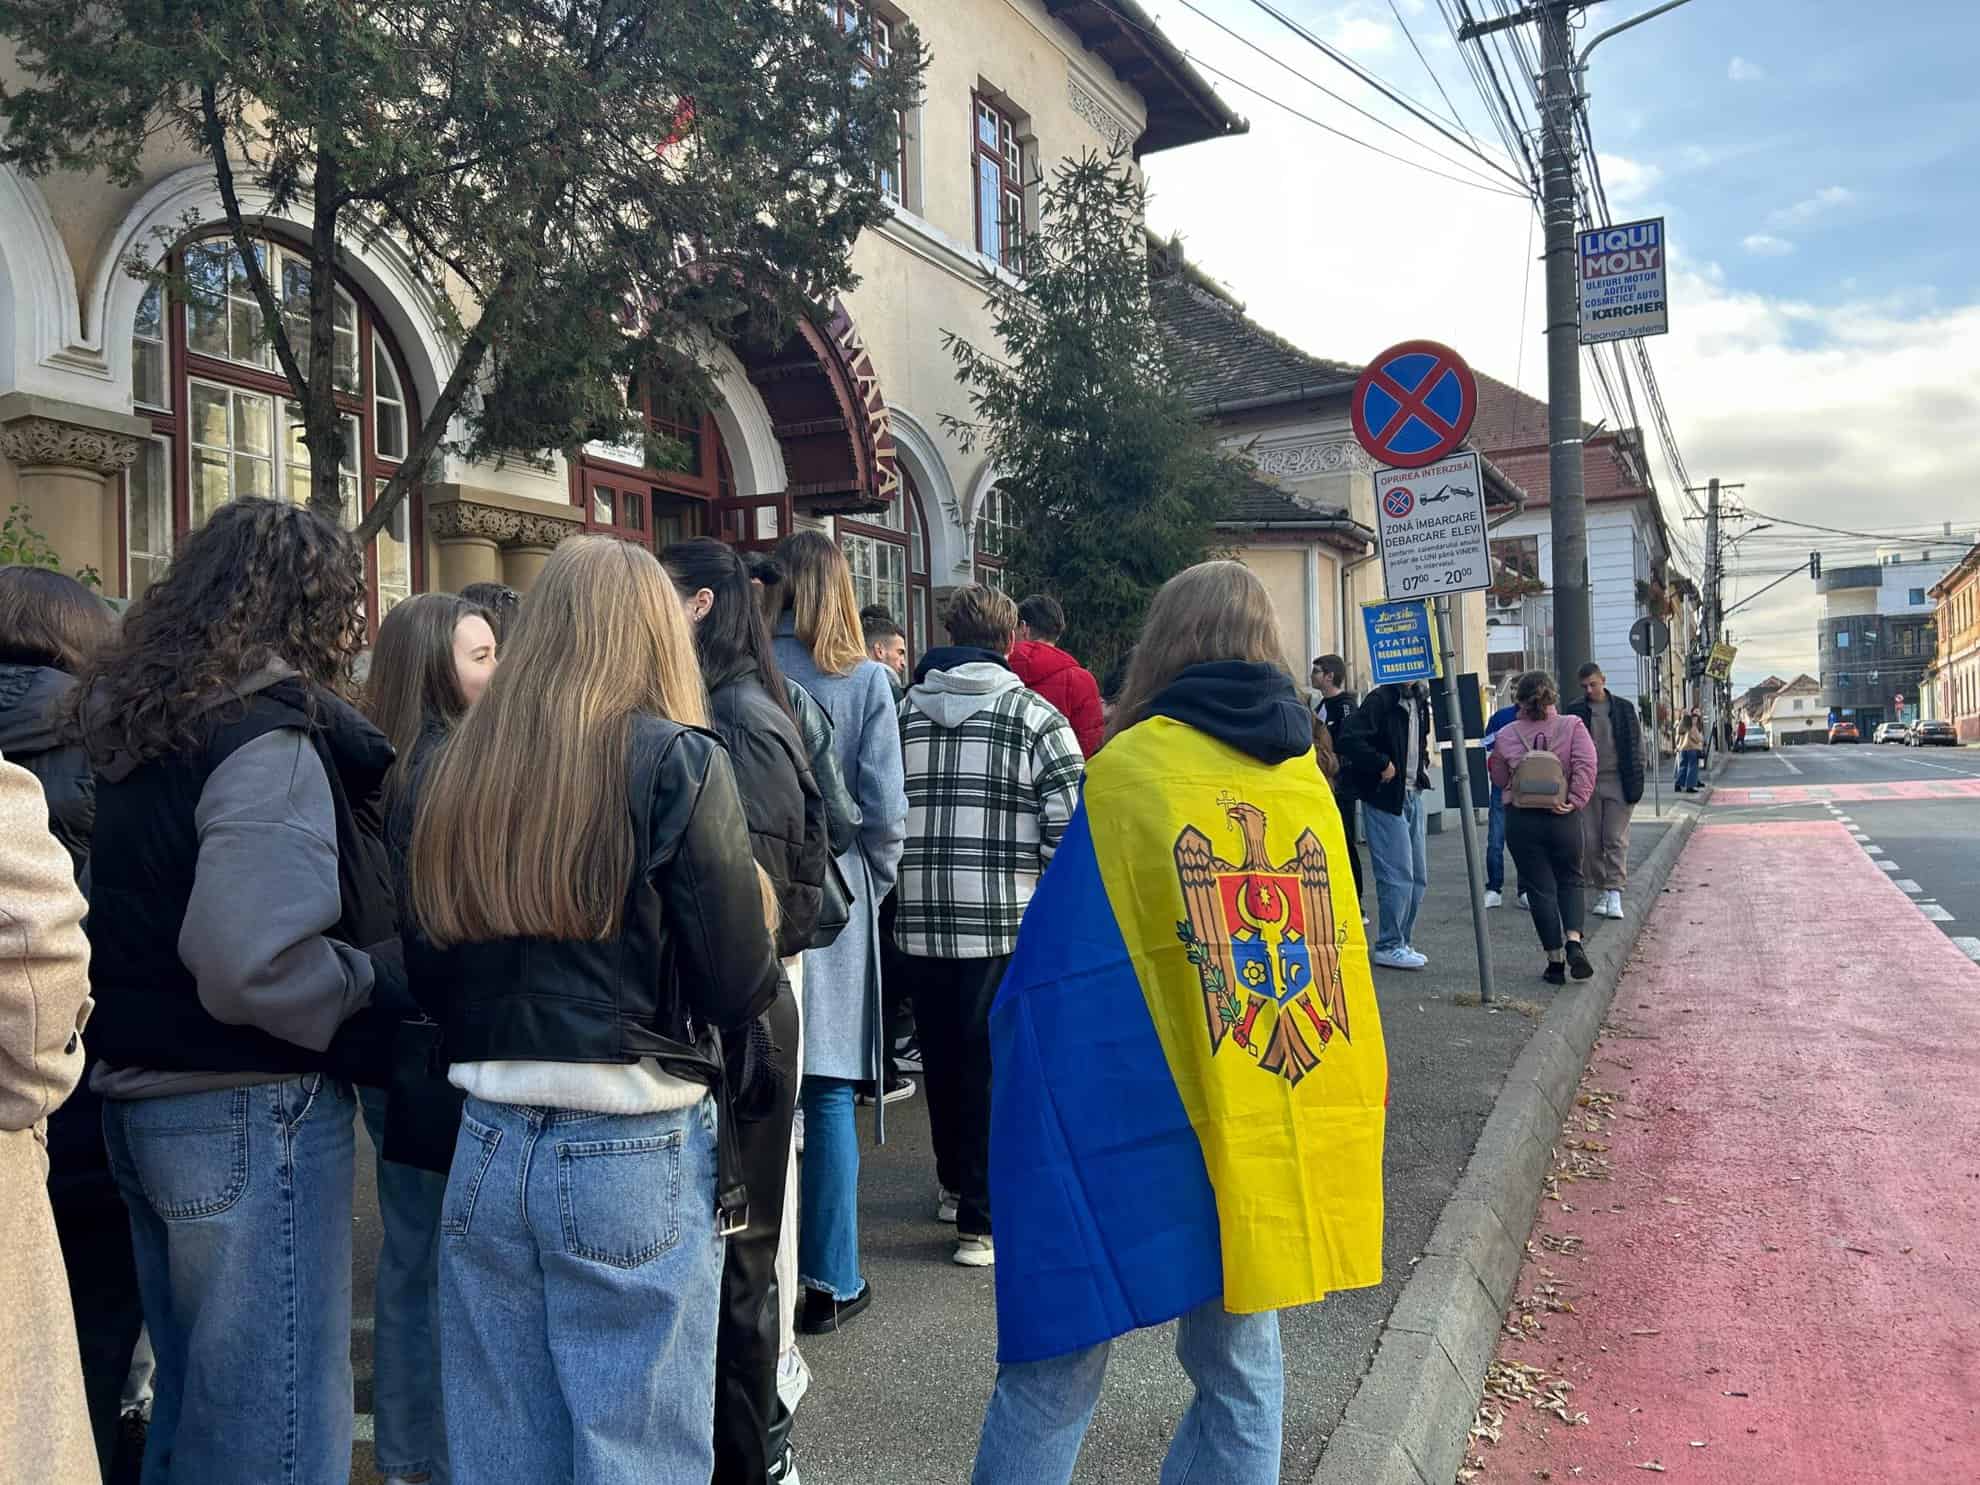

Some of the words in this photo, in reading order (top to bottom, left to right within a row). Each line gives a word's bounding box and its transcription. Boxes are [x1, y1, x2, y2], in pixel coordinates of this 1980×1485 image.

[1585, 224, 1656, 255] LIQUI
[1586, 248, 1658, 276] MOLY
[1586, 278, 1621, 289] ULEIURI
[1624, 272, 1657, 284] MOTOR
[1604, 284, 1637, 296] ADITIVI
[1585, 294, 1634, 308] COSMETICE
[1637, 289, 1660, 300] AUTO
[839, 323, 898, 497] MARIA
[1380, 472, 1419, 486] OPRIREA
[1385, 529, 1447, 548] DEBARCARE
[1451, 525, 1481, 537] ELEVI
